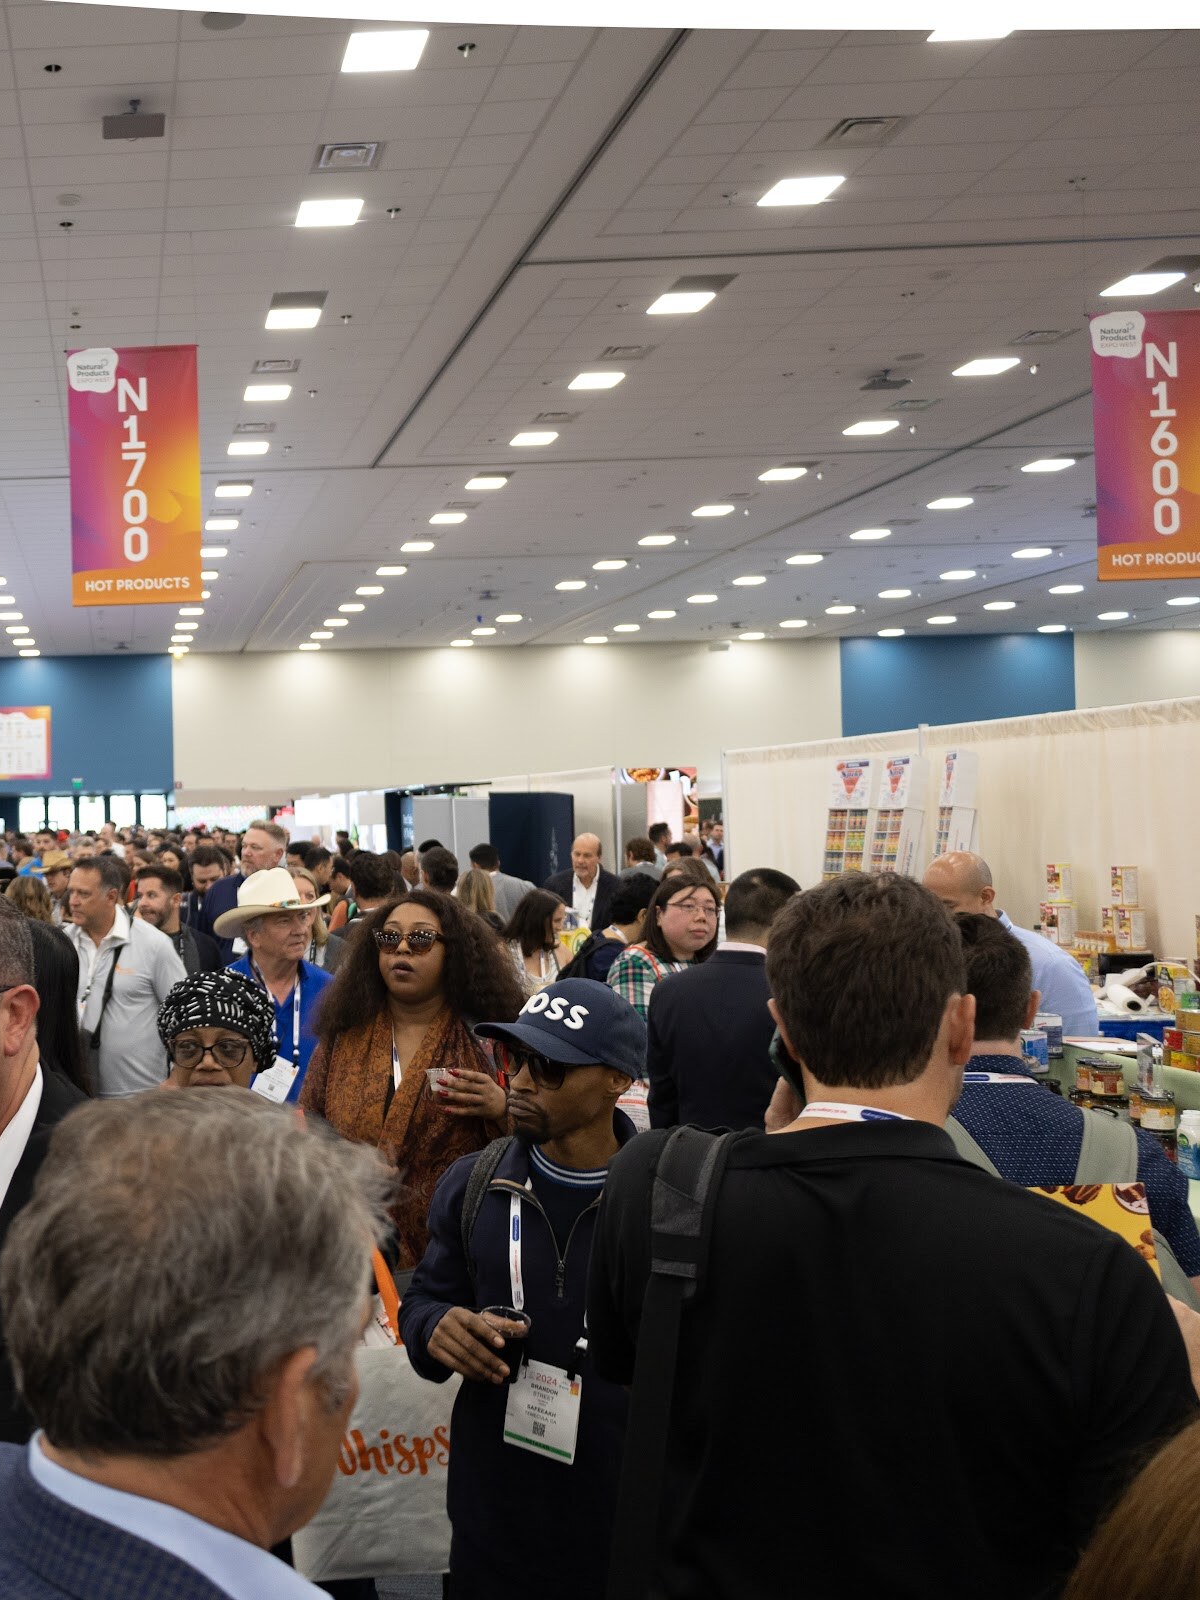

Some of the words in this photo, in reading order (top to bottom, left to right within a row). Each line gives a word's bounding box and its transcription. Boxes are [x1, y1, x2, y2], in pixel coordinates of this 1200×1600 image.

[1100, 327, 1130, 335] Natural
[1100, 333, 1136, 342] Products
[1145, 341, 1180, 535] N1600
[117, 377, 149, 562] N1700
[1112, 554, 1142, 567] HOT
[85, 580, 113, 592] HOT
[116, 577, 190, 591] PRODUCTS
[536, 1372, 557, 1386] 2024
